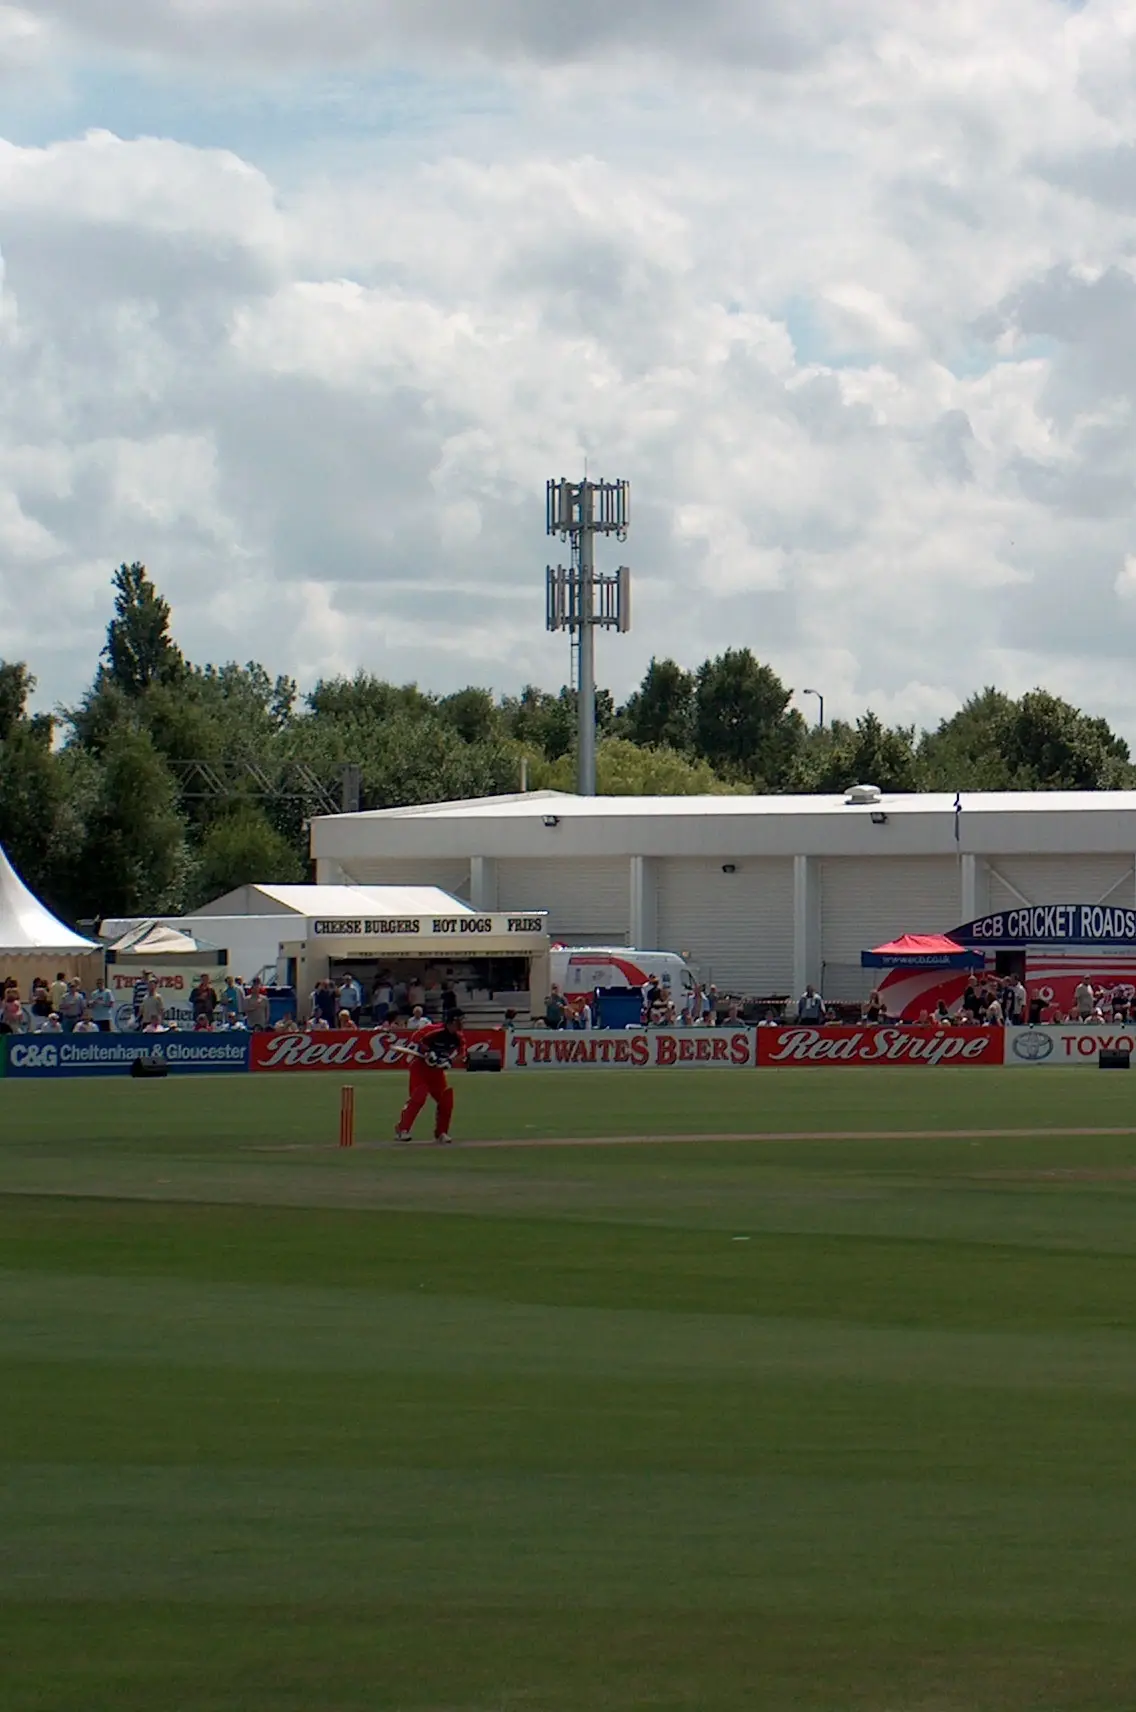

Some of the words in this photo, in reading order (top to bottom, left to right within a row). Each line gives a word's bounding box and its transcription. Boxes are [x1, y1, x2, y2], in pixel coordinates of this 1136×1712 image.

[314, 920, 361, 934] CHEESE
[364, 920, 420, 934] BURGERS
[433, 919, 457, 932] HOT
[460, 919, 492, 932] DOGS
[507, 918, 542, 932] FRIES
[973, 916, 1003, 937] ECB
[1007, 905, 1076, 938] CRICKET
[10, 1043, 57, 1067] C&G
[60, 1044, 150, 1060] Cheltenham
[152, 1044, 163, 1060] &
[166, 1044, 246, 1060] Gloucester
[258, 1032, 352, 1067] Red
[511, 1036, 648, 1066] THWAITES
[655, 1036, 750, 1066] BEERS
[769, 1029, 865, 1060] Red
[859, 1028, 990, 1065] Stripe
